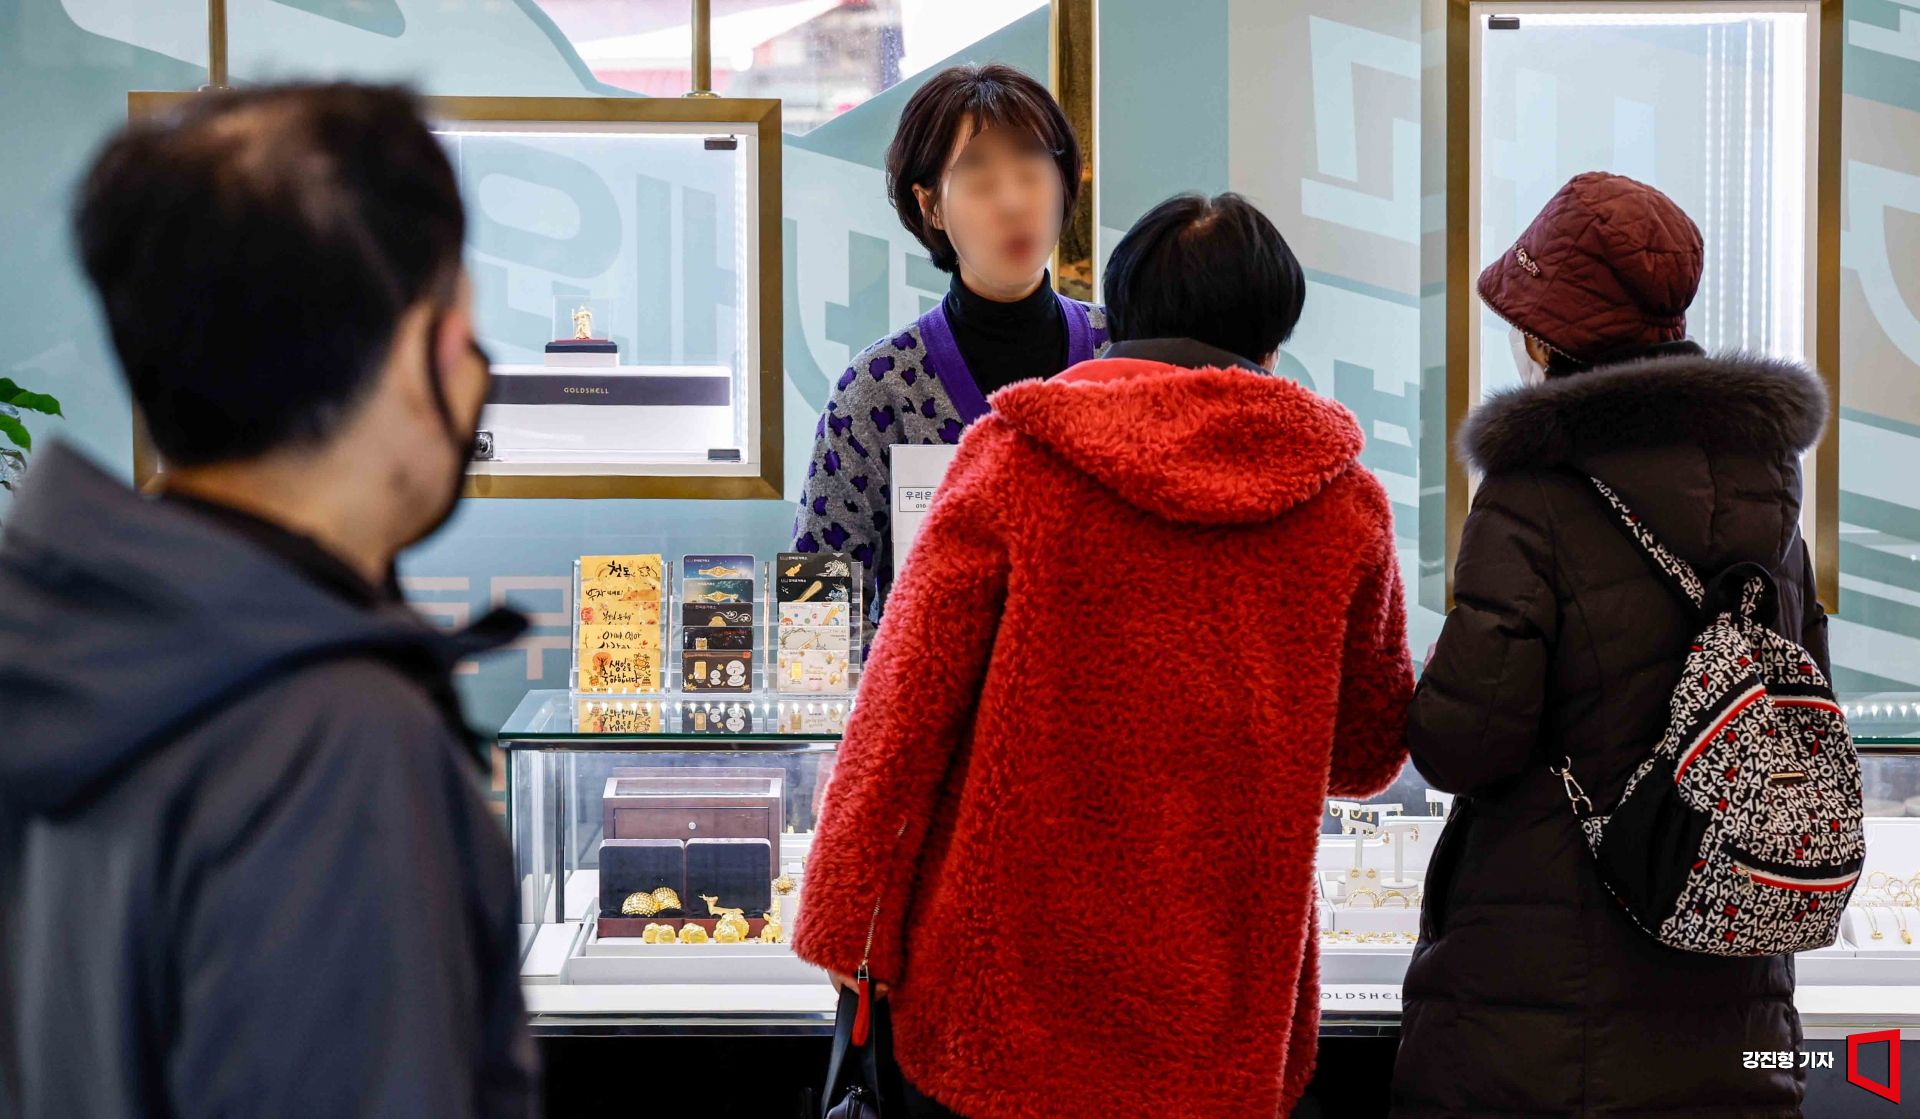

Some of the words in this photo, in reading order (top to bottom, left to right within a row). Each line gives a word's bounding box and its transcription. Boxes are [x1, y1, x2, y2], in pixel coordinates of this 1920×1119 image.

[905, 490, 936, 501] 우리은
[609, 658, 632, 673] 생일을
[601, 666, 643, 686] 축하합니다
